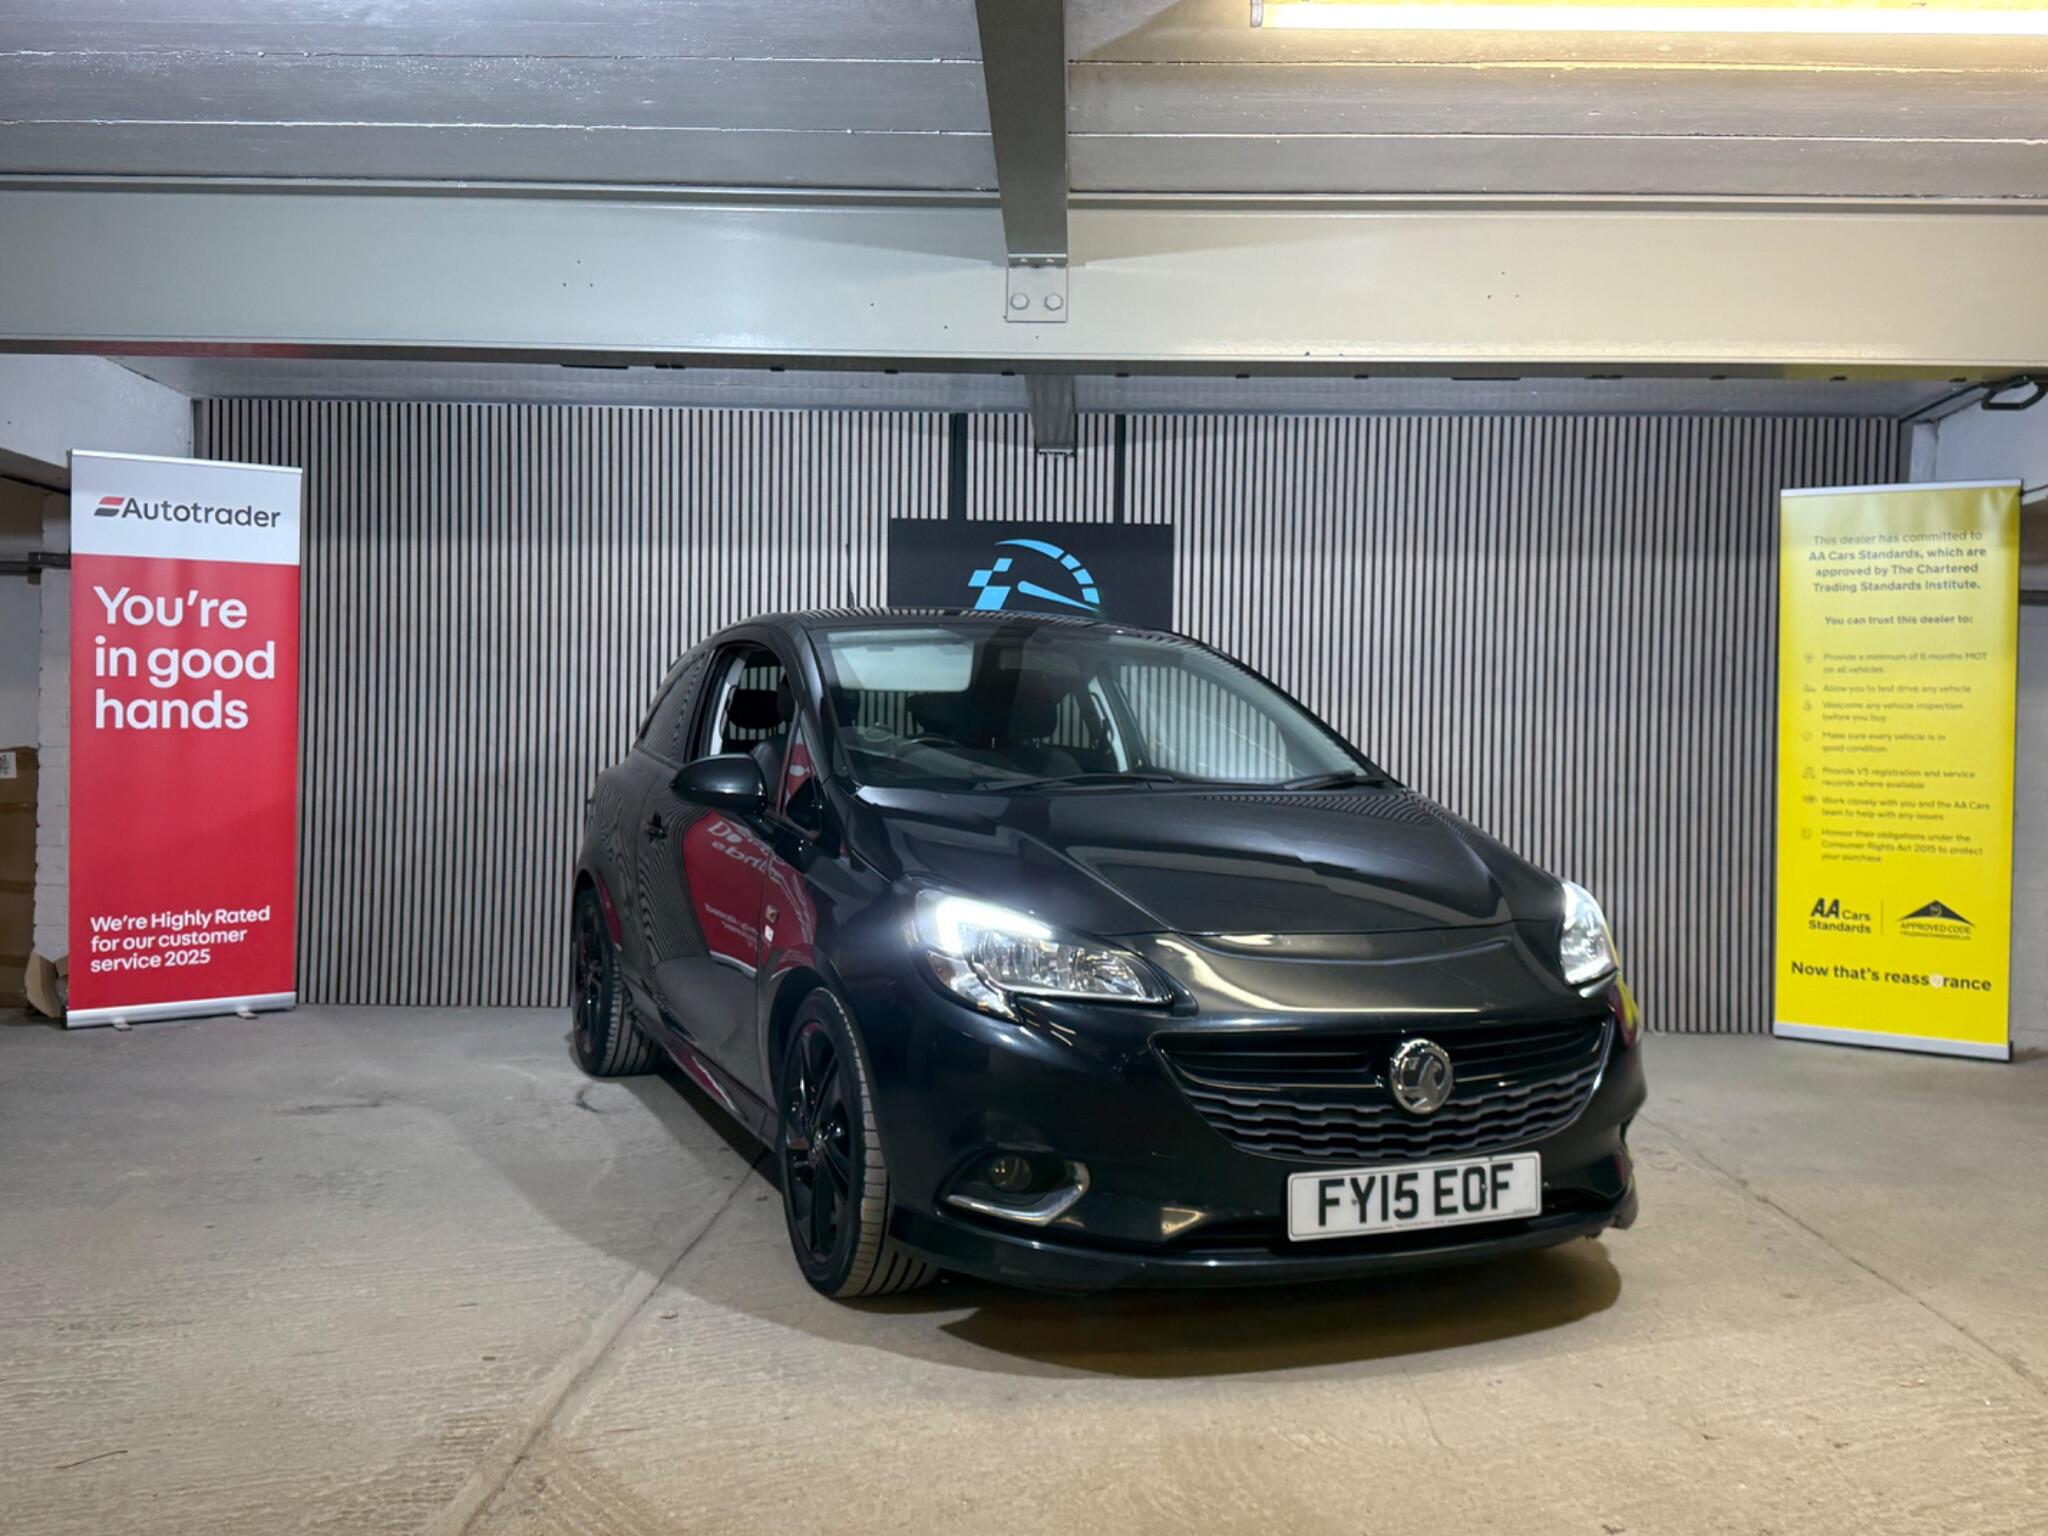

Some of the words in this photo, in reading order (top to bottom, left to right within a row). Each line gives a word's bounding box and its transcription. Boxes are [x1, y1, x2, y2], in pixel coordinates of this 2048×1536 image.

[122, 498, 280, 528] Autotrader
[1814, 536, 1837, 545] This
[1840, 534, 1876, 545] dealer
[1878, 534, 1900, 543] has
[1902, 531, 1966, 543] committed
[1969, 531, 1983, 541] to
[1809, 552, 1826, 562] AA
[1829, 551, 1855, 561] Cars
[1859, 549, 1924, 560] Standards,
[1927, 548, 1964, 558] which
[1967, 547, 1986, 557] are
[1815, 567, 1871, 578] approved
[1874, 566, 1888, 577] by
[1891, 565, 1913, 575] The
[1916, 563, 1978, 574] Chartered
[1813, 583, 1857, 593] Trading
[1860, 582, 1921, 592] Standards
[1925, 580, 1980, 590] Institute.
[93, 586, 248, 629] You're
[1825, 617, 1844, 625] You
[1846, 617, 1865, 625] can
[1897, 616, 1917, 624] this
[1920, 615, 1955, 624] dealer
[1958, 615, 1974, 624] to:
[95, 635, 137, 677] in
[147, 640, 275, 688] good
[95, 688, 248, 729] hands
[91, 915, 147, 932] We're
[151, 910, 212, 931] Highly
[215, 905, 271, 924] Rated
[1811, 898, 1839, 918] AA
[1842, 910, 1871, 921] Cars
[1808, 920, 1872, 934] Standards
[91, 936, 119, 952] for
[123, 936, 155, 950] our
[158, 929, 247, 947] customer
[91, 953, 161, 973] service
[164, 949, 211, 967] 2025
[1791, 961, 1829, 976] Now
[1834, 966, 1880, 981] that's
[1318, 1172, 1418, 1227] FY15
[1434, 1162, 1513, 1216] EOF
